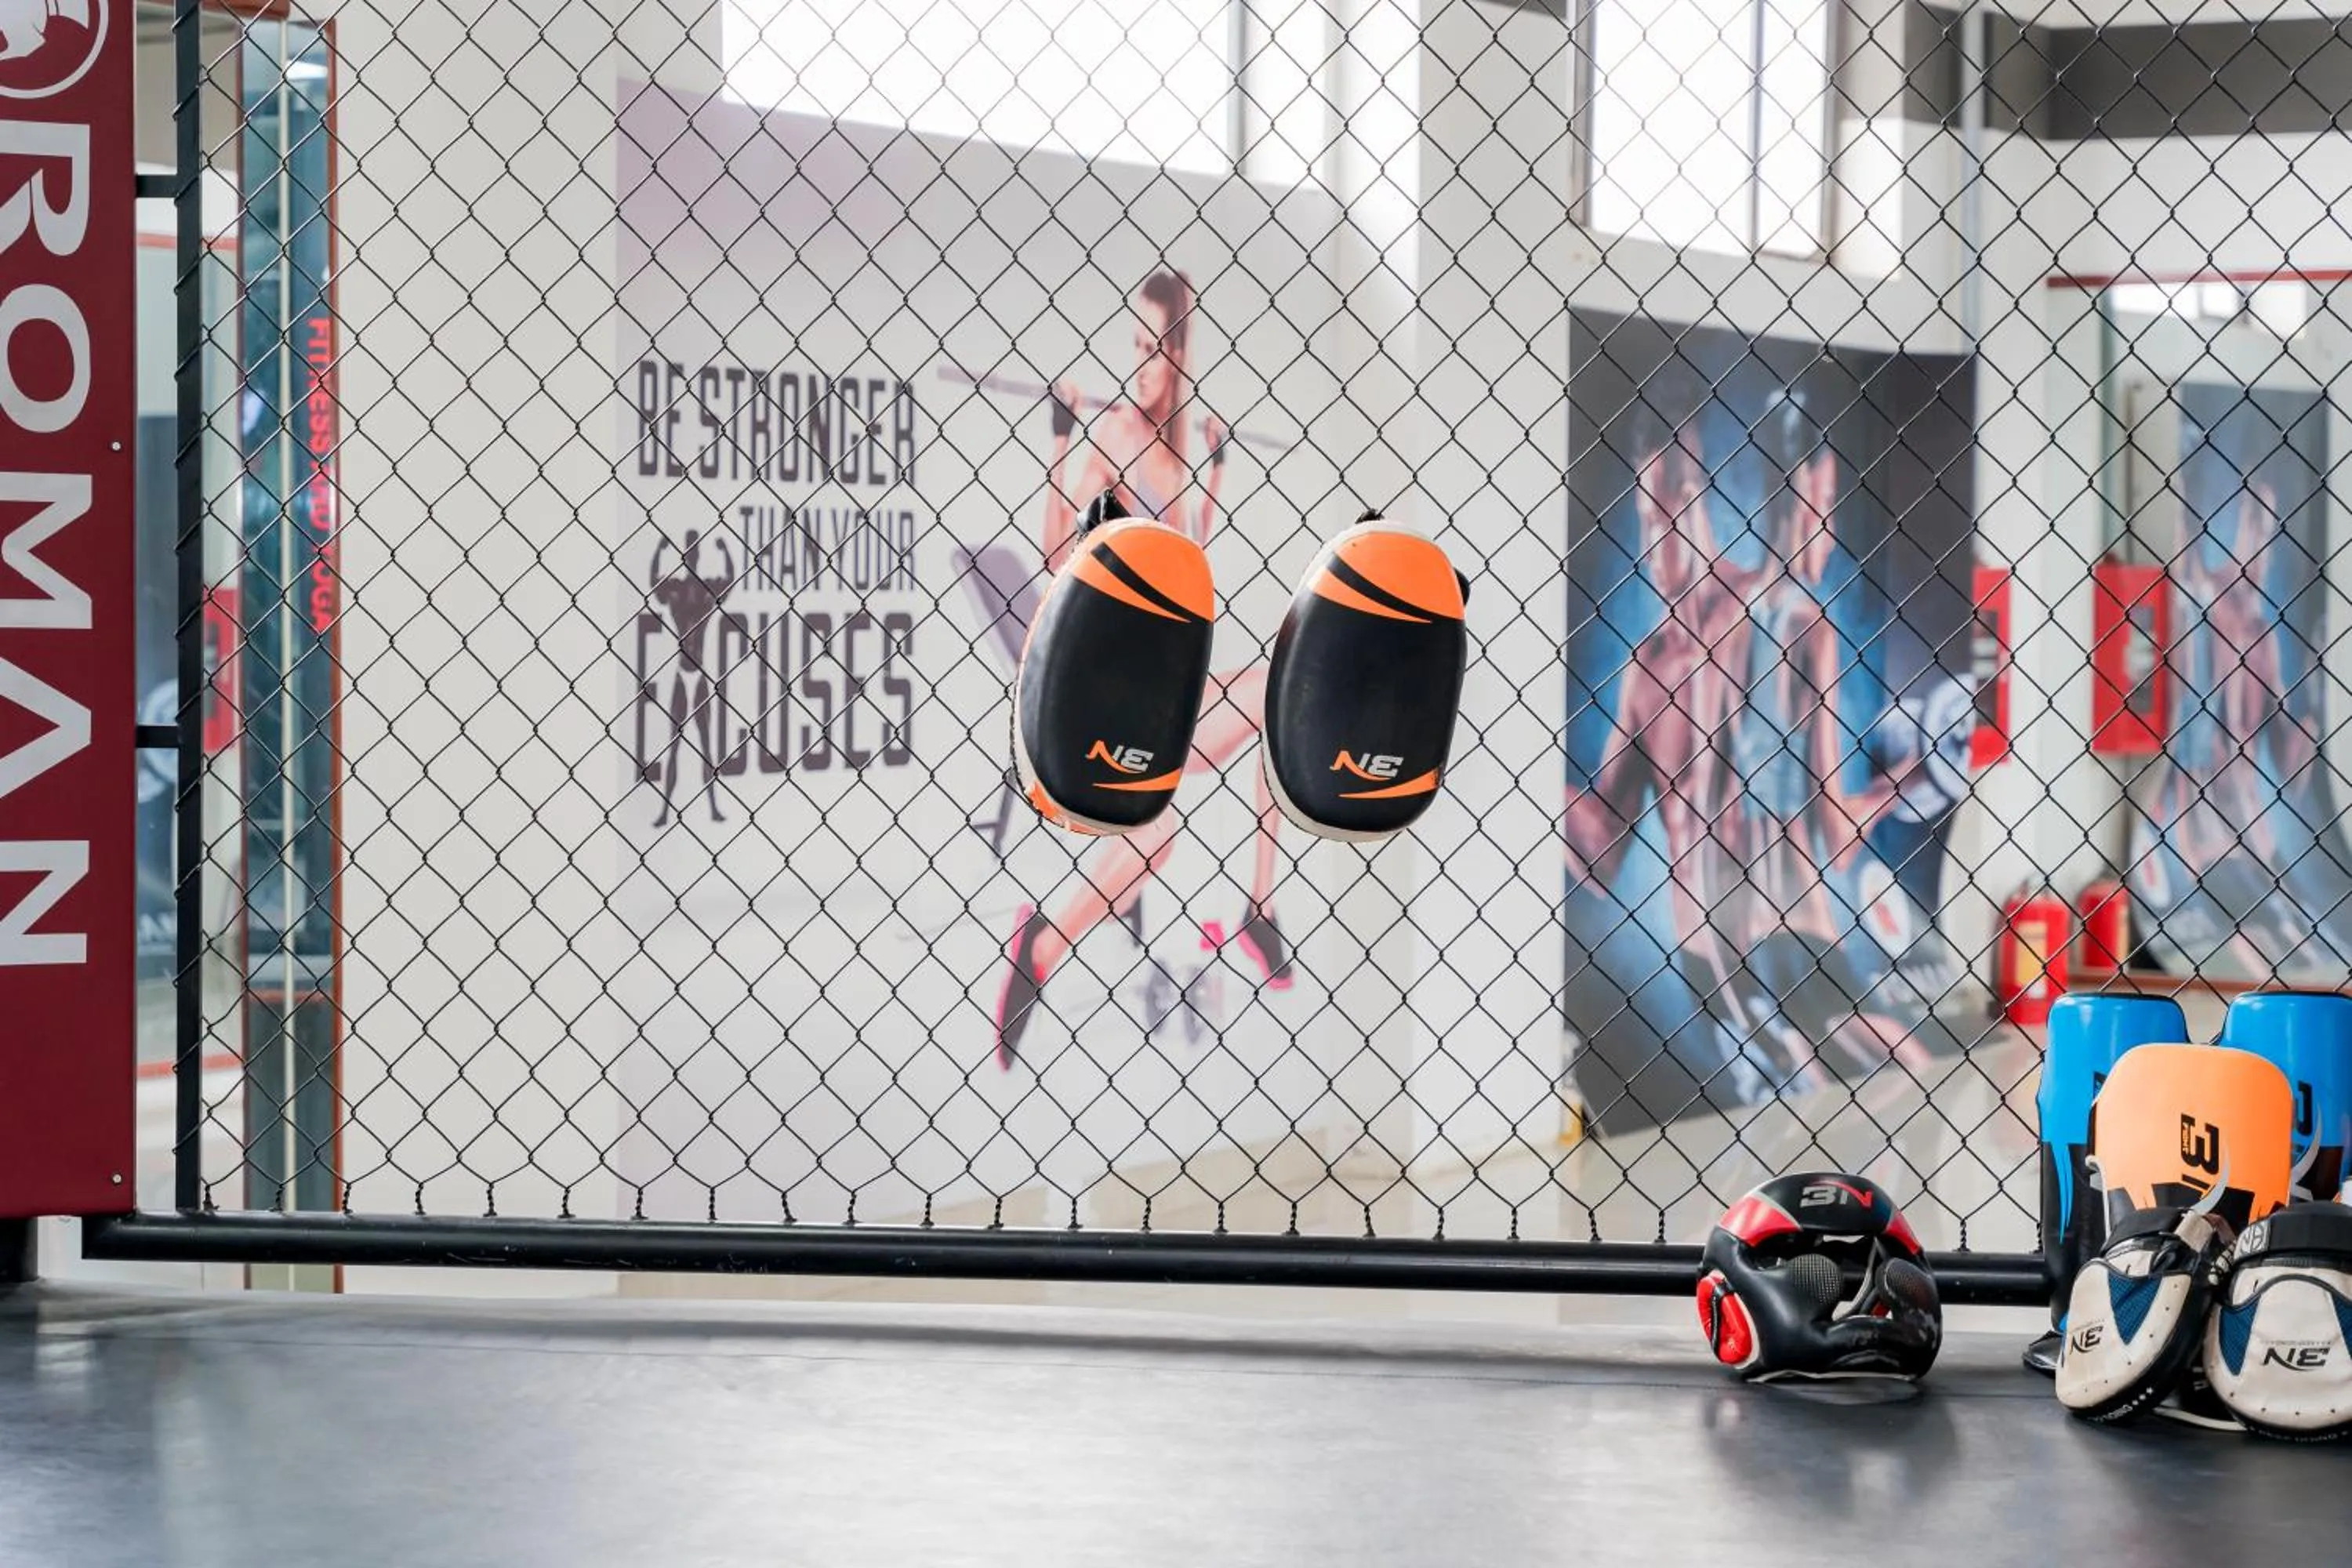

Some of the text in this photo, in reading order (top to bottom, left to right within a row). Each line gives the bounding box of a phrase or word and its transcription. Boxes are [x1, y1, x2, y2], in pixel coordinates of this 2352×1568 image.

[307, 318, 332, 453] FITNESS
[638, 360, 916, 487] BE STRONGER
[0, 120, 93, 964] ROMAN
[309, 545, 334, 633] YOGA
[739, 506, 915, 592] THAN YOUR
